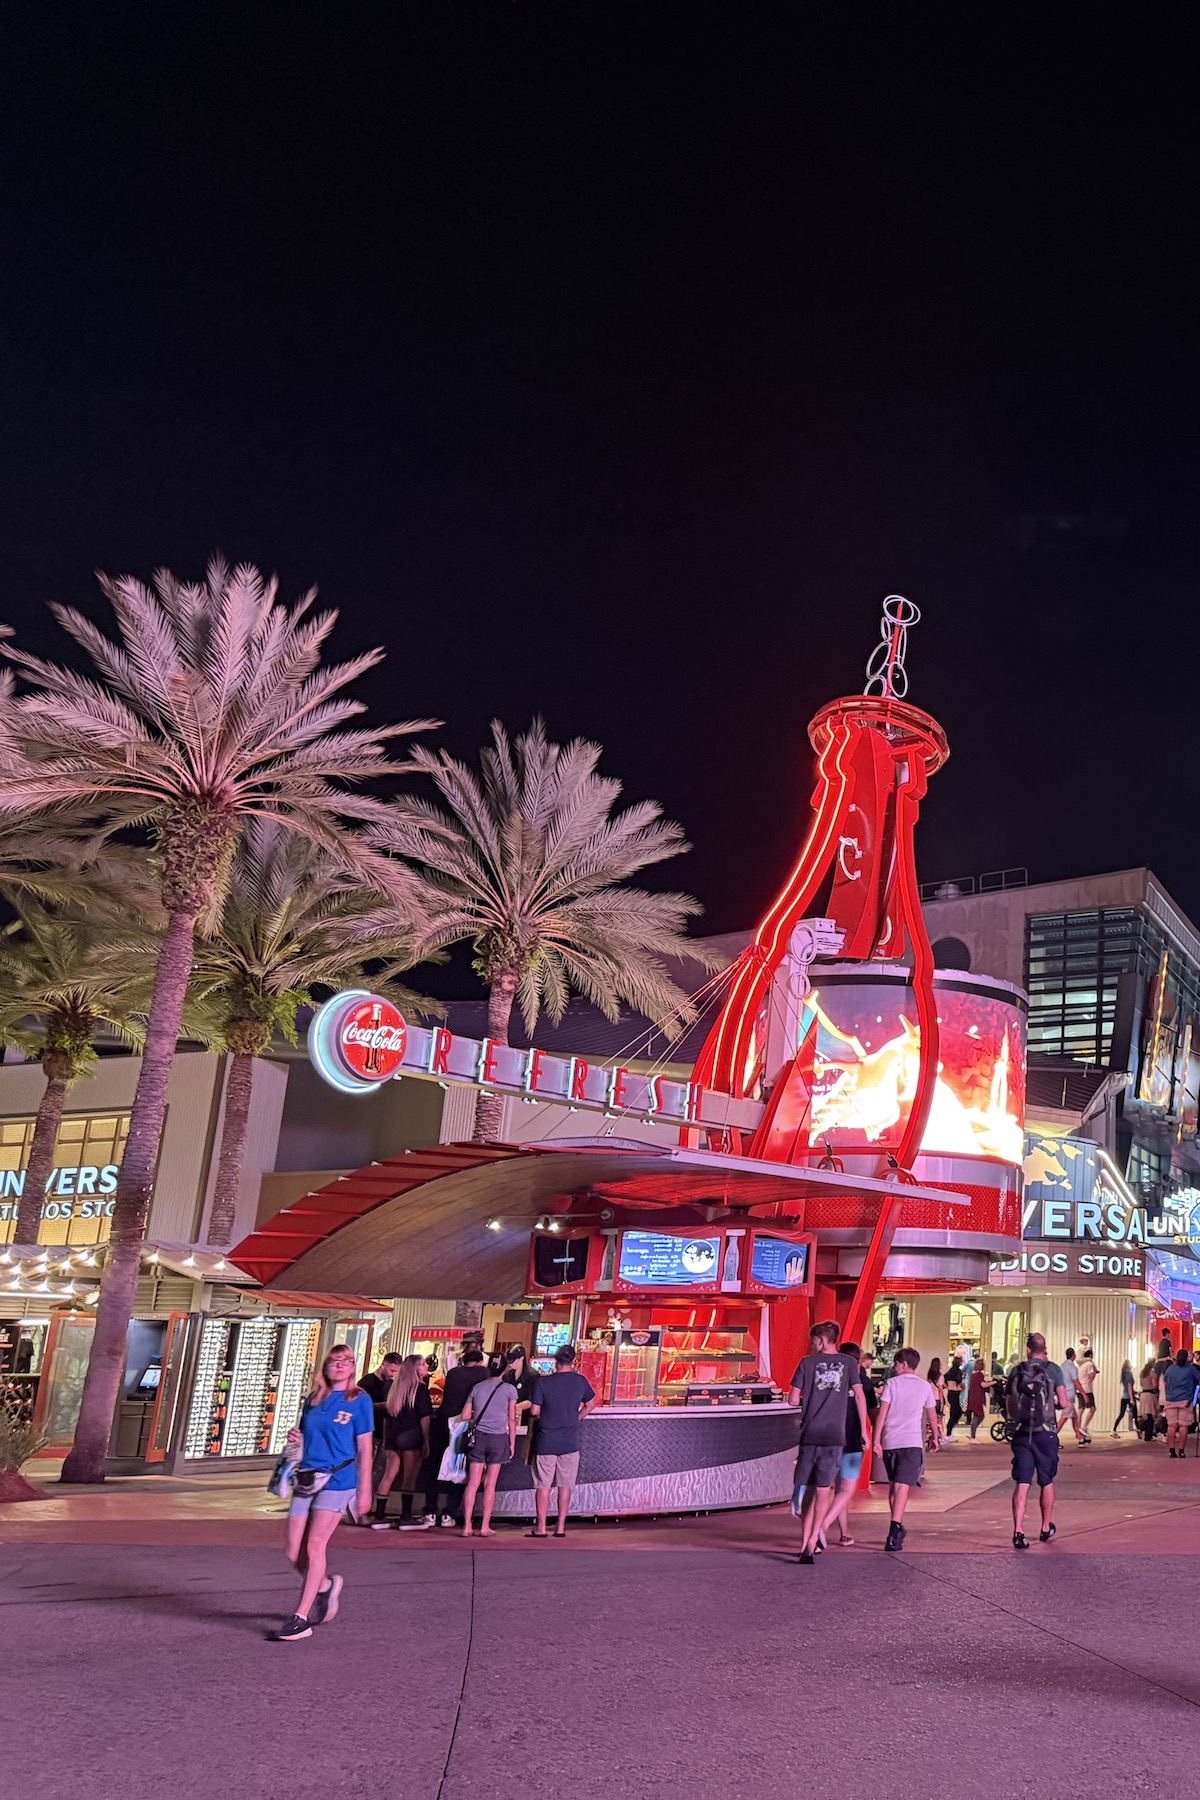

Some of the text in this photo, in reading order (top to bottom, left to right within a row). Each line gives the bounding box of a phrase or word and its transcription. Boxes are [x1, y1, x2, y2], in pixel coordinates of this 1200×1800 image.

[428, 1026, 704, 1122] REFRESH
[80, 1199, 116, 1218] STO
[1079, 1254, 1142, 1277] STORE
[412, 1330, 448, 1338] POPCORN
